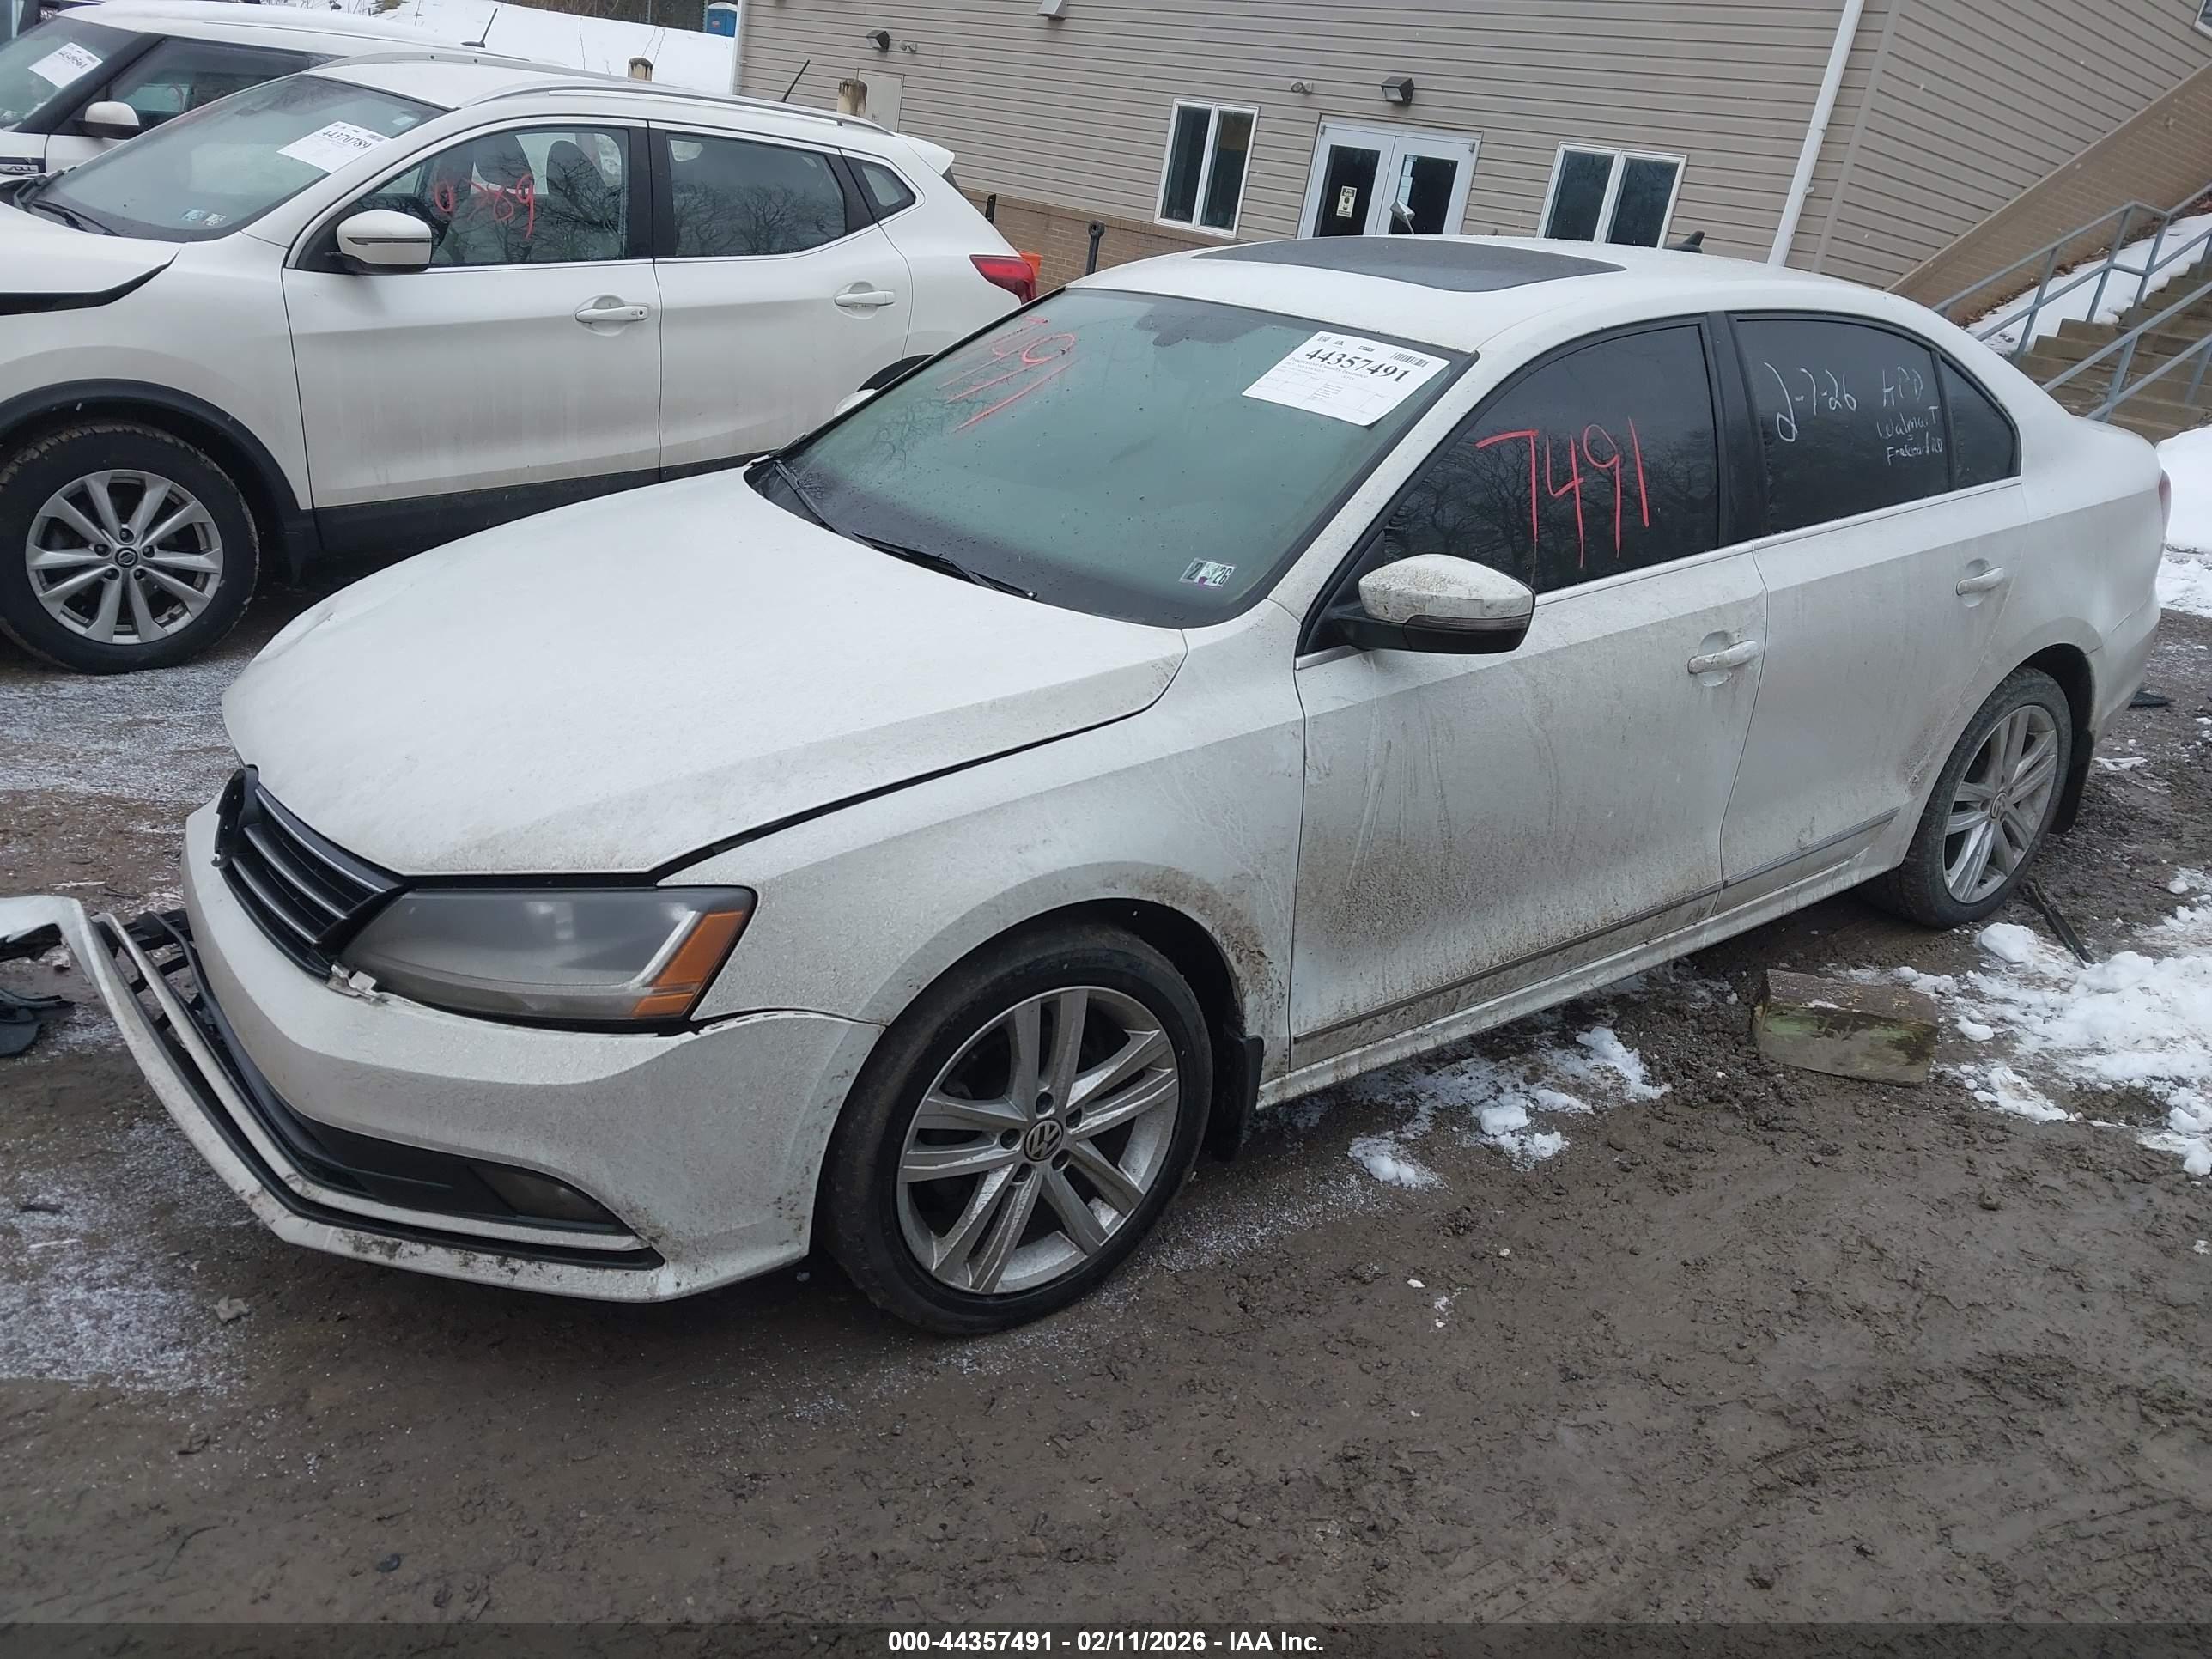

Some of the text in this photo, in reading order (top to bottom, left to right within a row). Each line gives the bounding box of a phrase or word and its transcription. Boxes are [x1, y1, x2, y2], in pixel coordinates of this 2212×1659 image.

[322, 130, 373, 149] 44370789
[1305, 348, 1411, 382] 44357491
[1475, 416, 1650, 570] 7491
